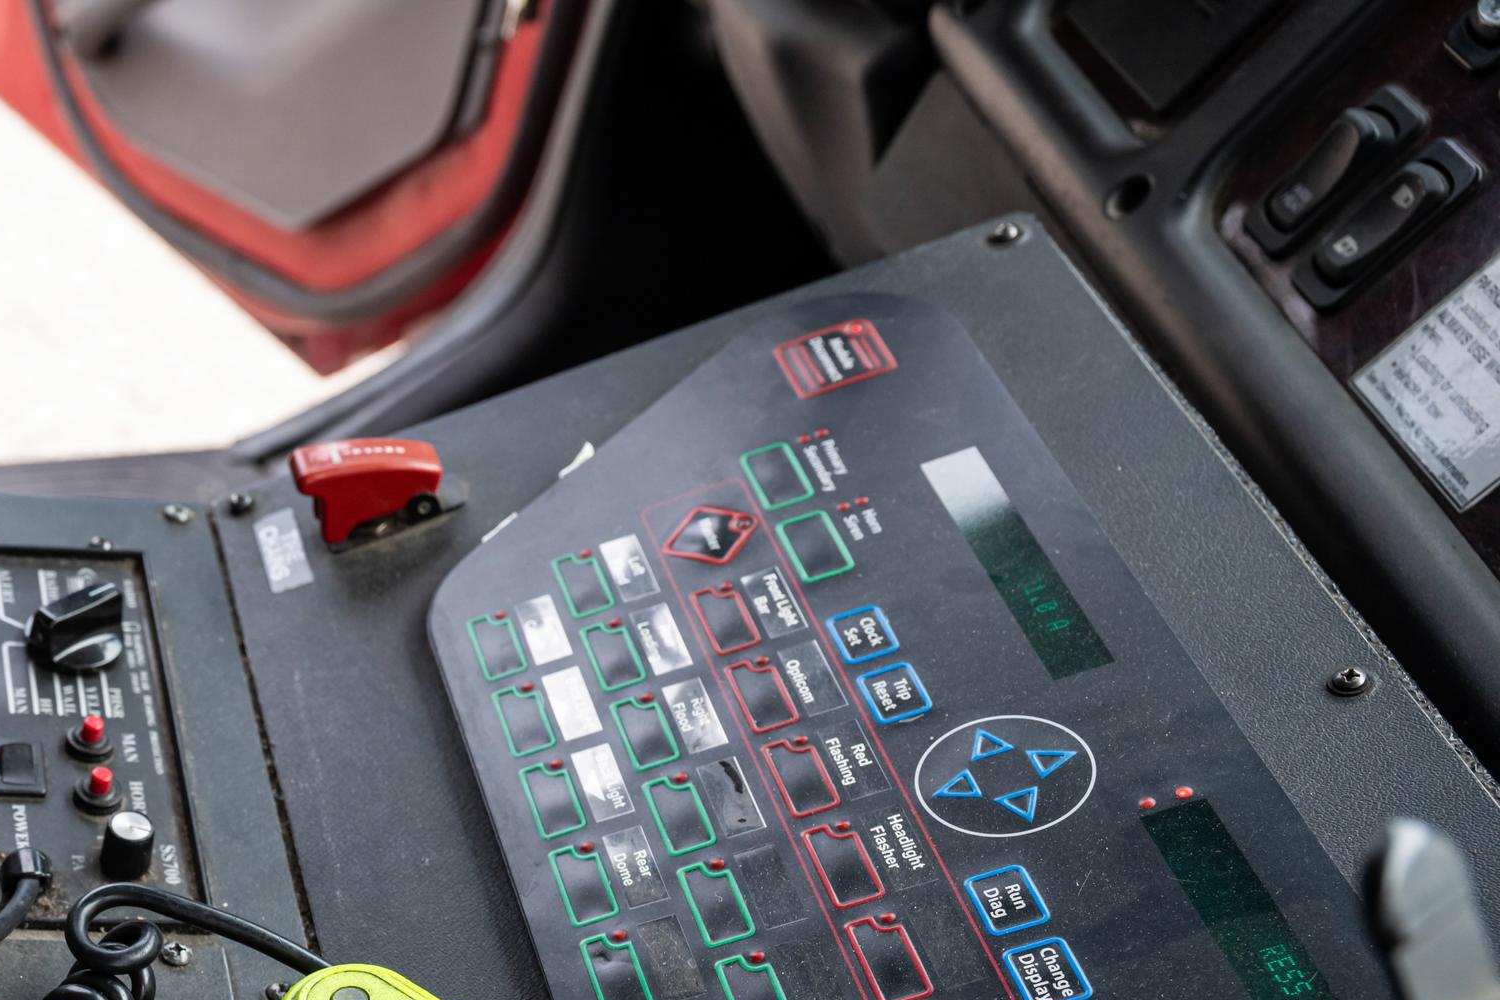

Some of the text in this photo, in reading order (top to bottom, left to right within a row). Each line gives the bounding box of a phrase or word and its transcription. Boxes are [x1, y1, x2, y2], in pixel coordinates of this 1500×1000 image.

[776, 598, 800, 628] Light
[845, 627, 862, 646] Set
[860, 616, 885, 648] Clock
[786, 659, 815, 705] Opticom
[872, 680, 897, 711] Reset
[894, 678, 912, 701] Trip
[673, 702, 694, 733] Flood
[122, 733, 139, 763] MAN
[825, 737, 857, 786] Flashing
[851, 742, 873, 768] Red
[870, 825, 900, 870] Flasher
[887, 814, 926, 871] Headlight
[71, 854, 85, 871] PA
[160, 844, 181, 885] SS700
[613, 853, 633, 887] Dome
[632, 850, 652, 878] Rear
[983, 887, 1008, 919] Diag
[1004, 882, 1027, 910] Run
[1039, 946, 1074, 999] Change
